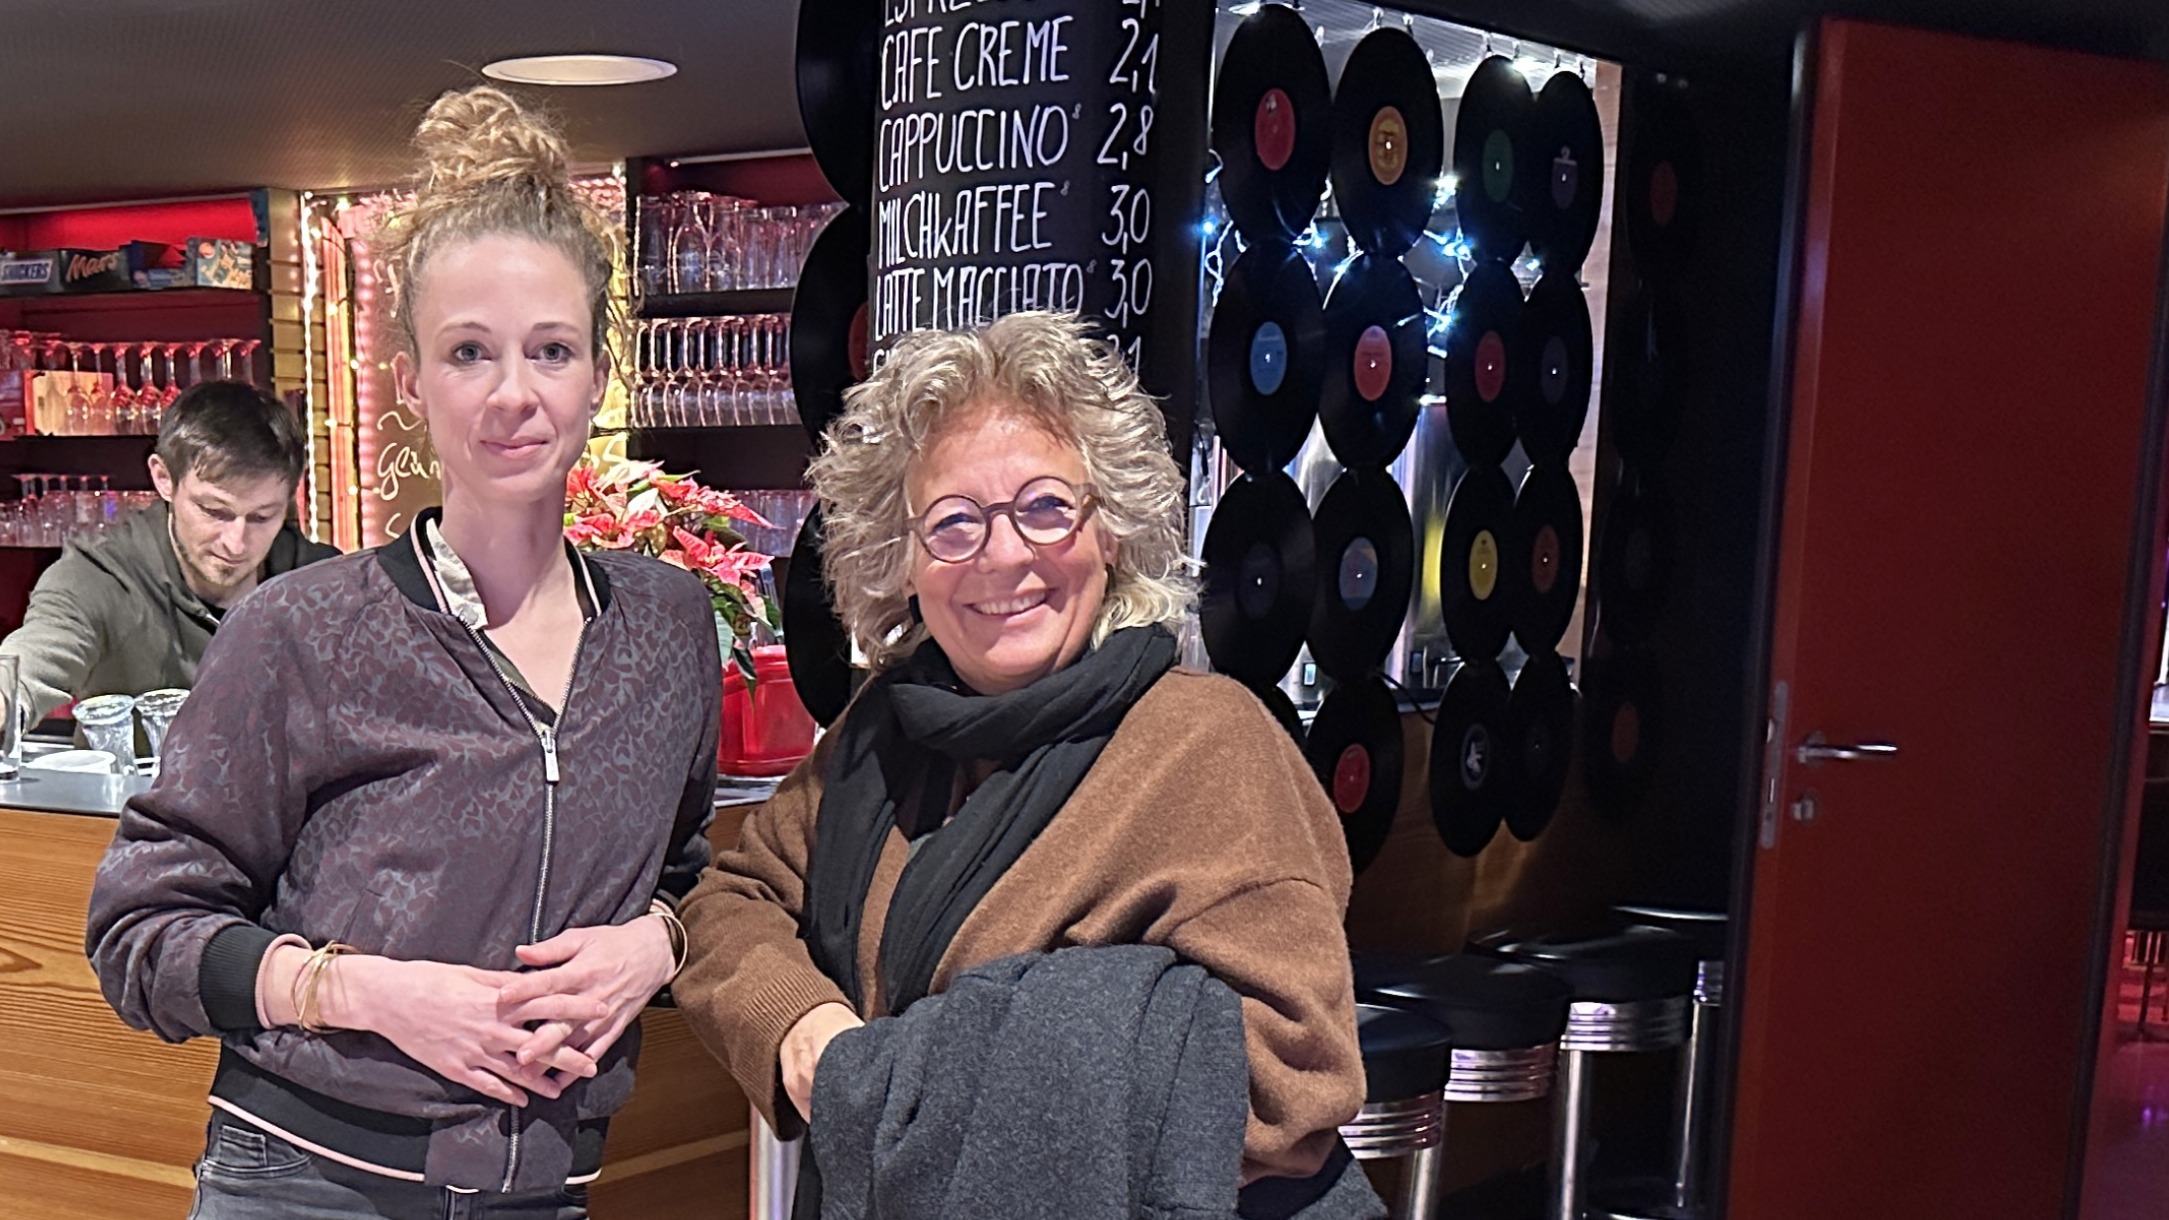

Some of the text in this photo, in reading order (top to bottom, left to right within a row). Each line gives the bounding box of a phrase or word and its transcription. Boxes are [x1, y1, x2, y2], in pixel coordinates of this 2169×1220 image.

[880, 15, 1160, 110] CAFE CREME 2,1
[878, 104, 1069, 193] CAPPUCCINO
[1096, 102, 1154, 171] 2,8
[1101, 184, 1151, 256] 3,0
[874, 267, 926, 343] LATTE
[1104, 258, 1153, 329] 3,0
